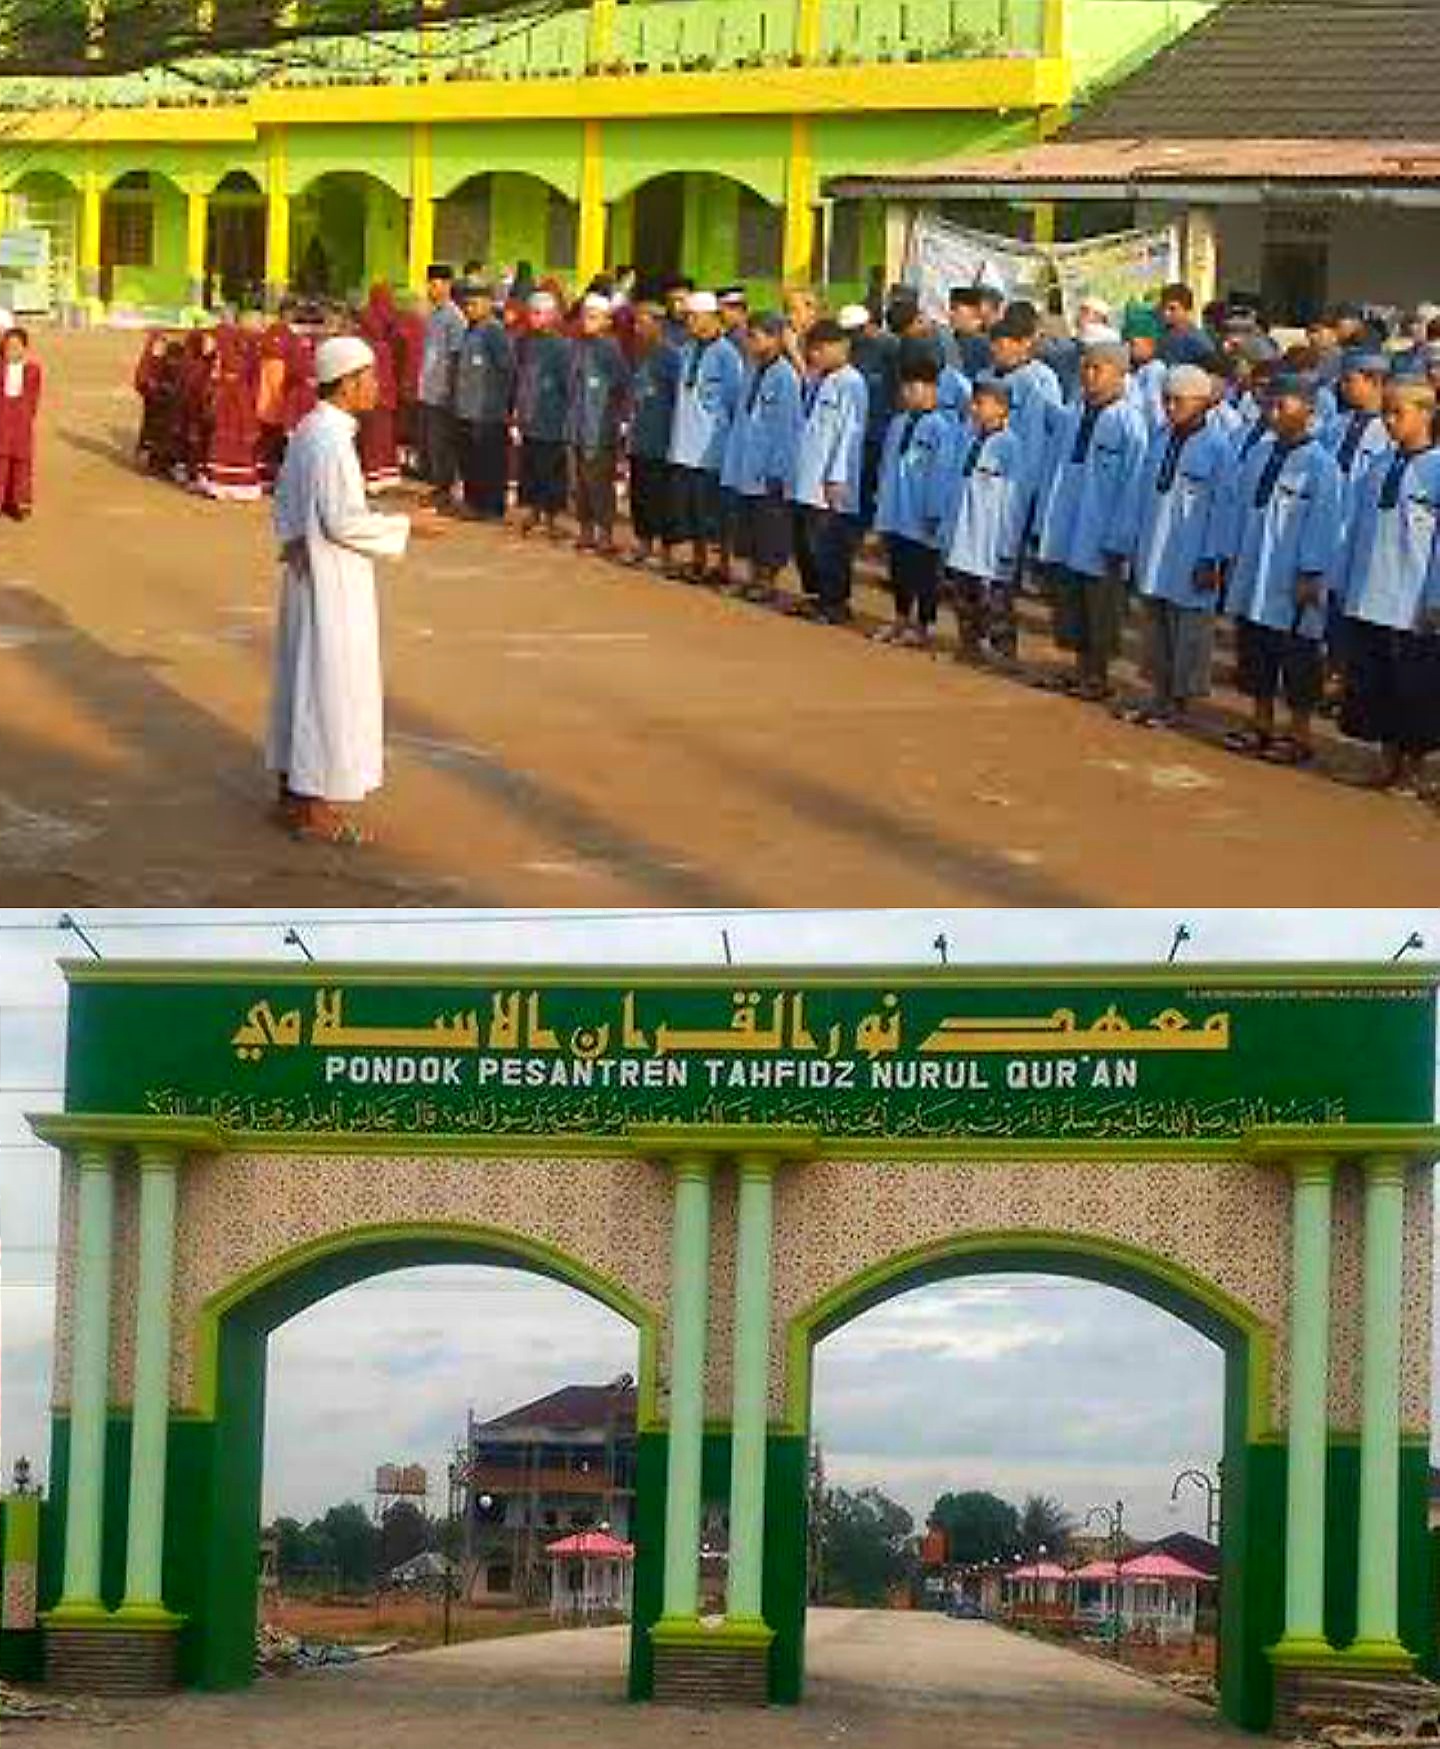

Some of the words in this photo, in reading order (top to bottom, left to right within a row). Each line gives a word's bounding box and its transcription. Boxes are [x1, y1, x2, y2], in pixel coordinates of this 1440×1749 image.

[326, 1056, 461, 1085] PONDOK
[478, 1057, 688, 1088] PESANTREN
[704, 1060, 856, 1089] TAHFIDZ
[871, 1061, 989, 1090] NURUL
